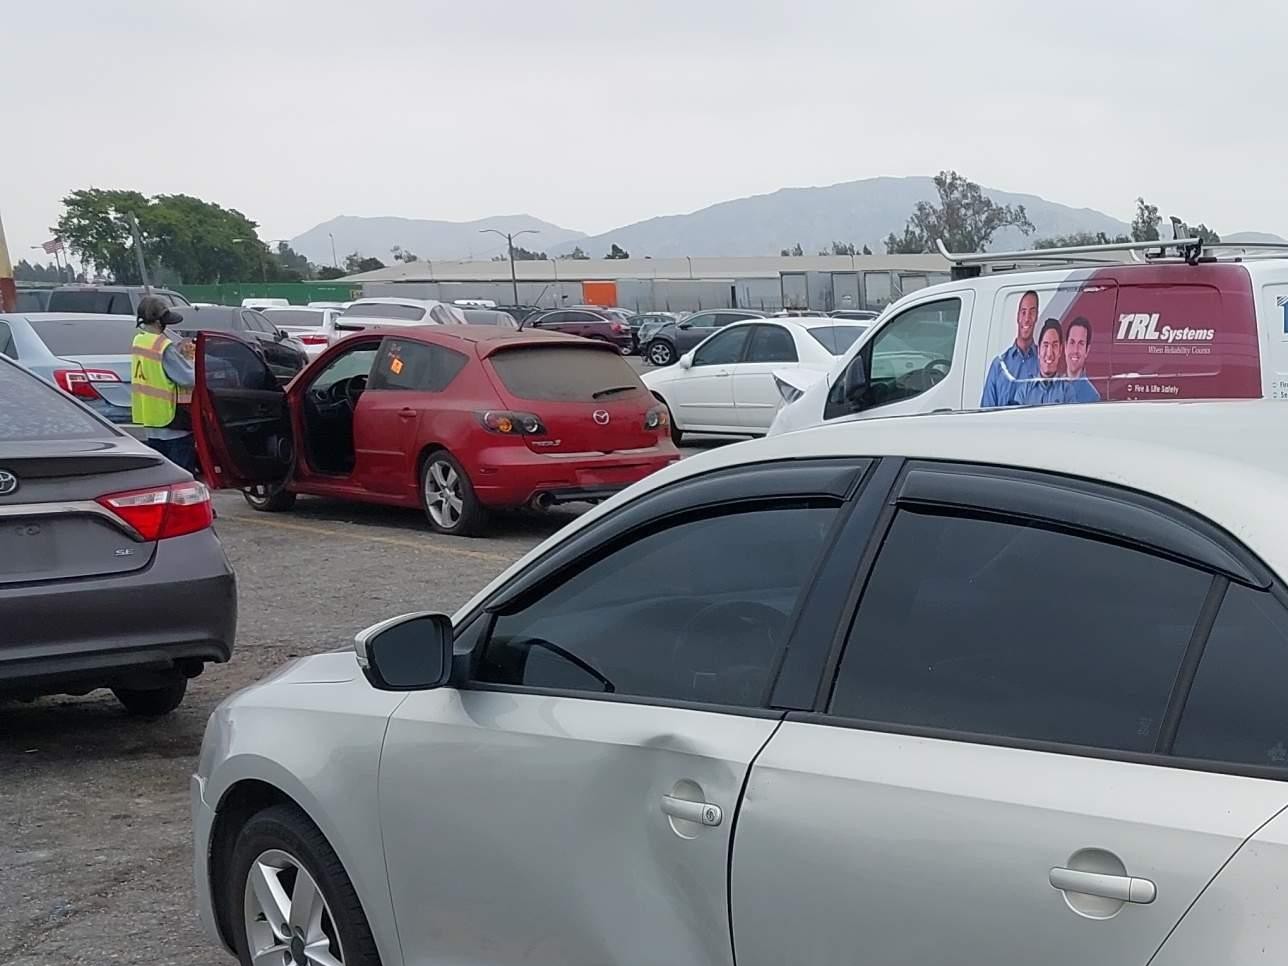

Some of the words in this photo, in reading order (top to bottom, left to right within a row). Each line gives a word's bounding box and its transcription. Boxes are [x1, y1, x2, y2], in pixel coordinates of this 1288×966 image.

[1116, 313, 1160, 340] TRL
[1160, 326, 1215, 343] Systems
[1148, 346, 1164, 354] When
[1164, 346, 1190, 357] Reliability
[1191, 346, 1211, 354] Counts
[1134, 384, 1145, 392] Fire
[1150, 385, 1160, 393] Life
[1161, 385, 1179, 395] Safety
